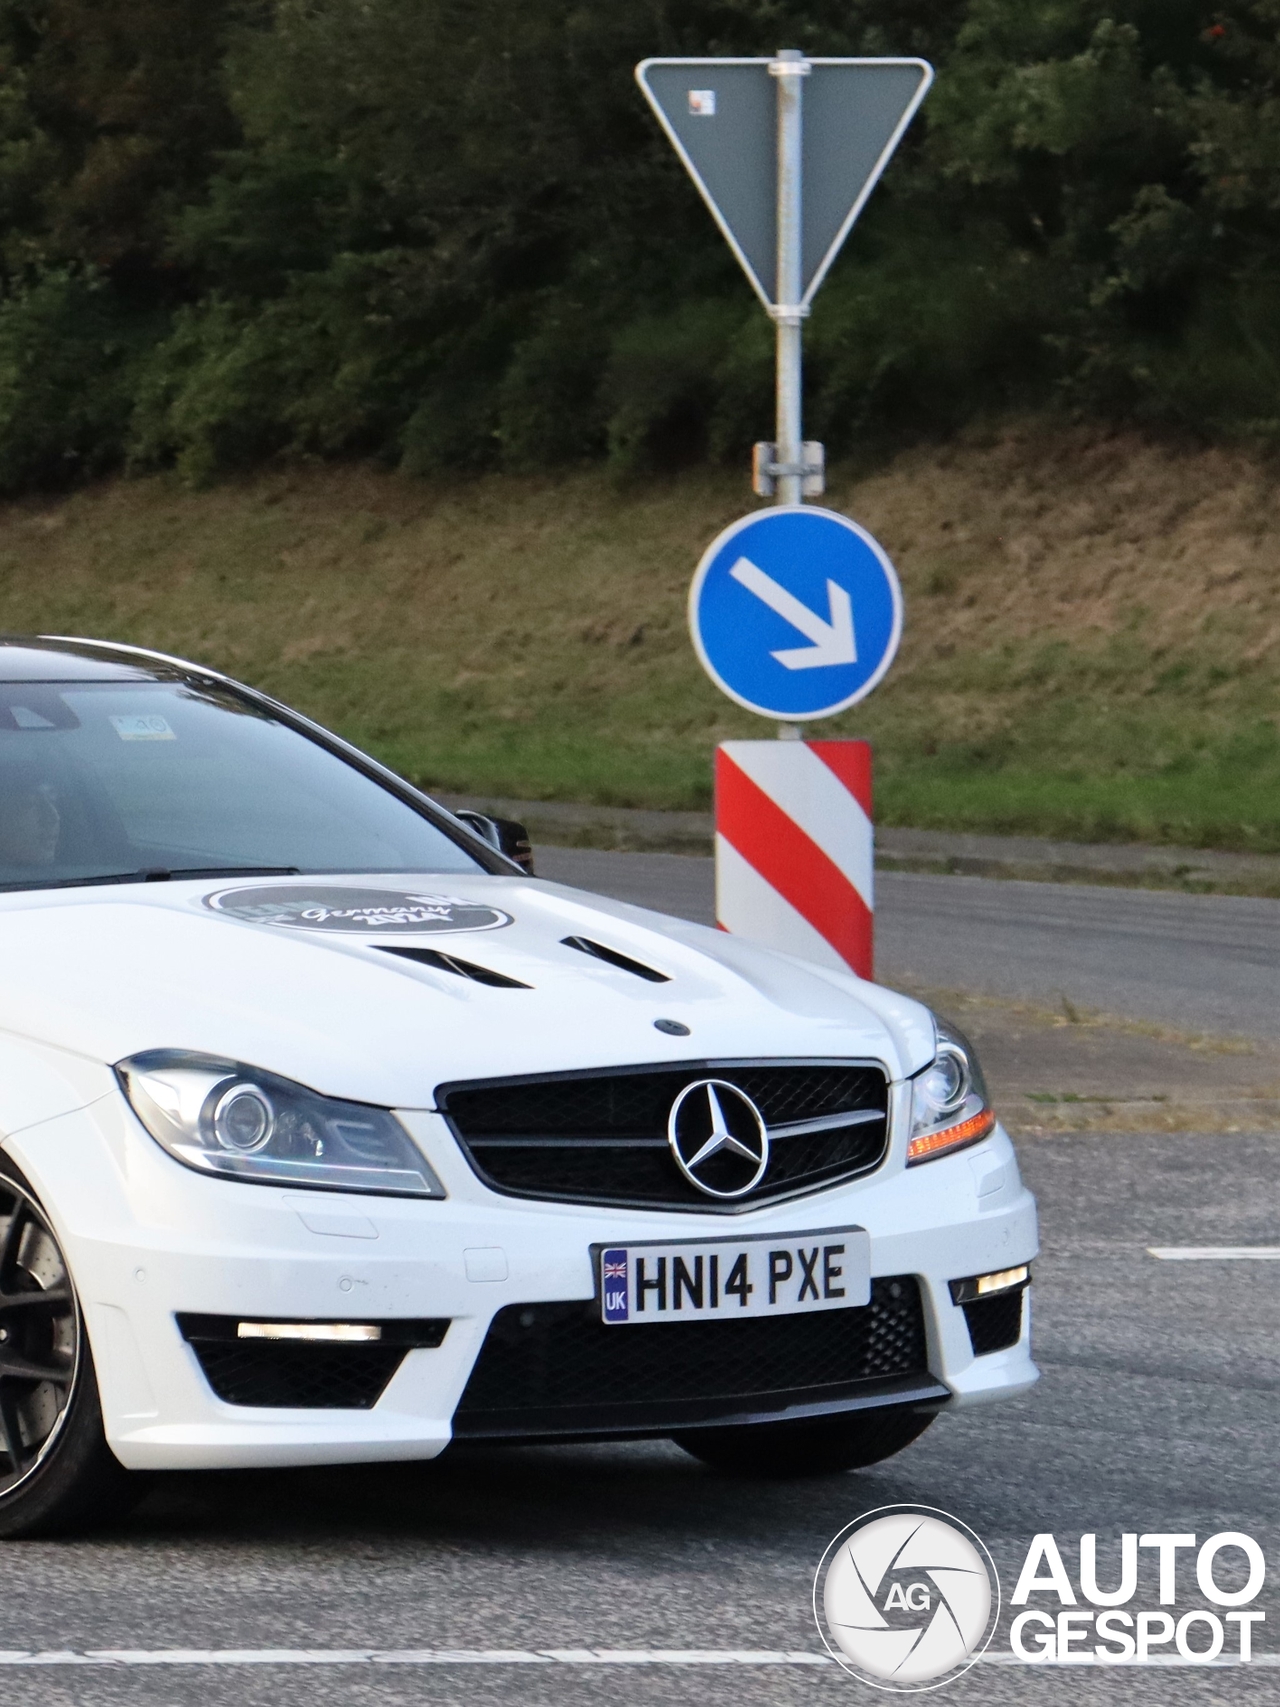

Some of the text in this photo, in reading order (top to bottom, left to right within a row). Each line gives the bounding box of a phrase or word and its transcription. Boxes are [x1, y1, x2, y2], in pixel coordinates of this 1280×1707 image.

[301, 906, 452, 922] Germany
[636, 1244, 845, 1311] HN14 PXE
[606, 1291, 626, 1310] UK
